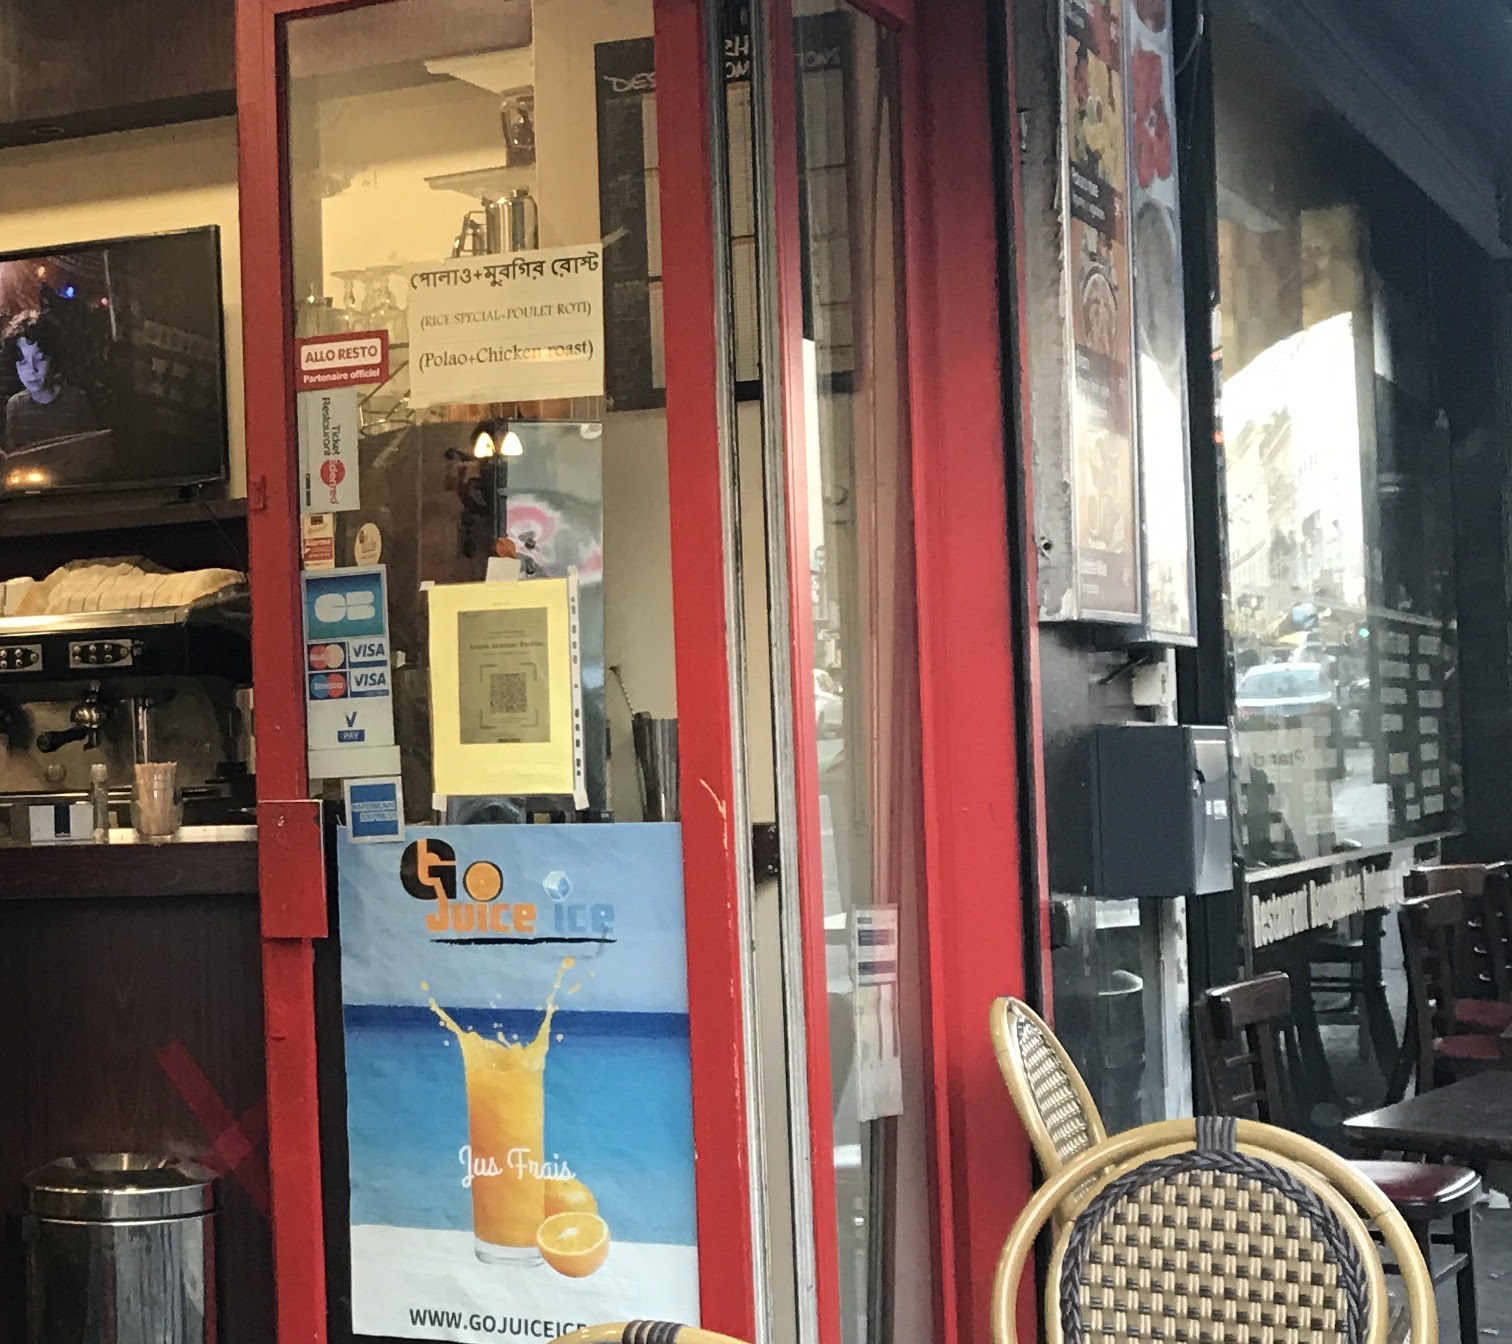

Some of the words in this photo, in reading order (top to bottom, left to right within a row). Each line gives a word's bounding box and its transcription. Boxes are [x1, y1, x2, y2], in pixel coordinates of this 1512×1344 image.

[304, 349, 335, 363] ALLO
[338, 345, 378, 360] RESTO
[303, 372, 348, 384] Partenaire
[350, 368, 380, 380] officiel
[322, 397, 331, 456] Restaurant
[332, 425, 341, 456] Ticket
[352, 643, 385, 657] VISA
[354, 673, 386, 687] VISA
[458, 1145, 503, 1188] Jus
[507, 1148, 576, 1181] Frais
[409, 1308, 587, 1338] WWW.GOJUICEIC
